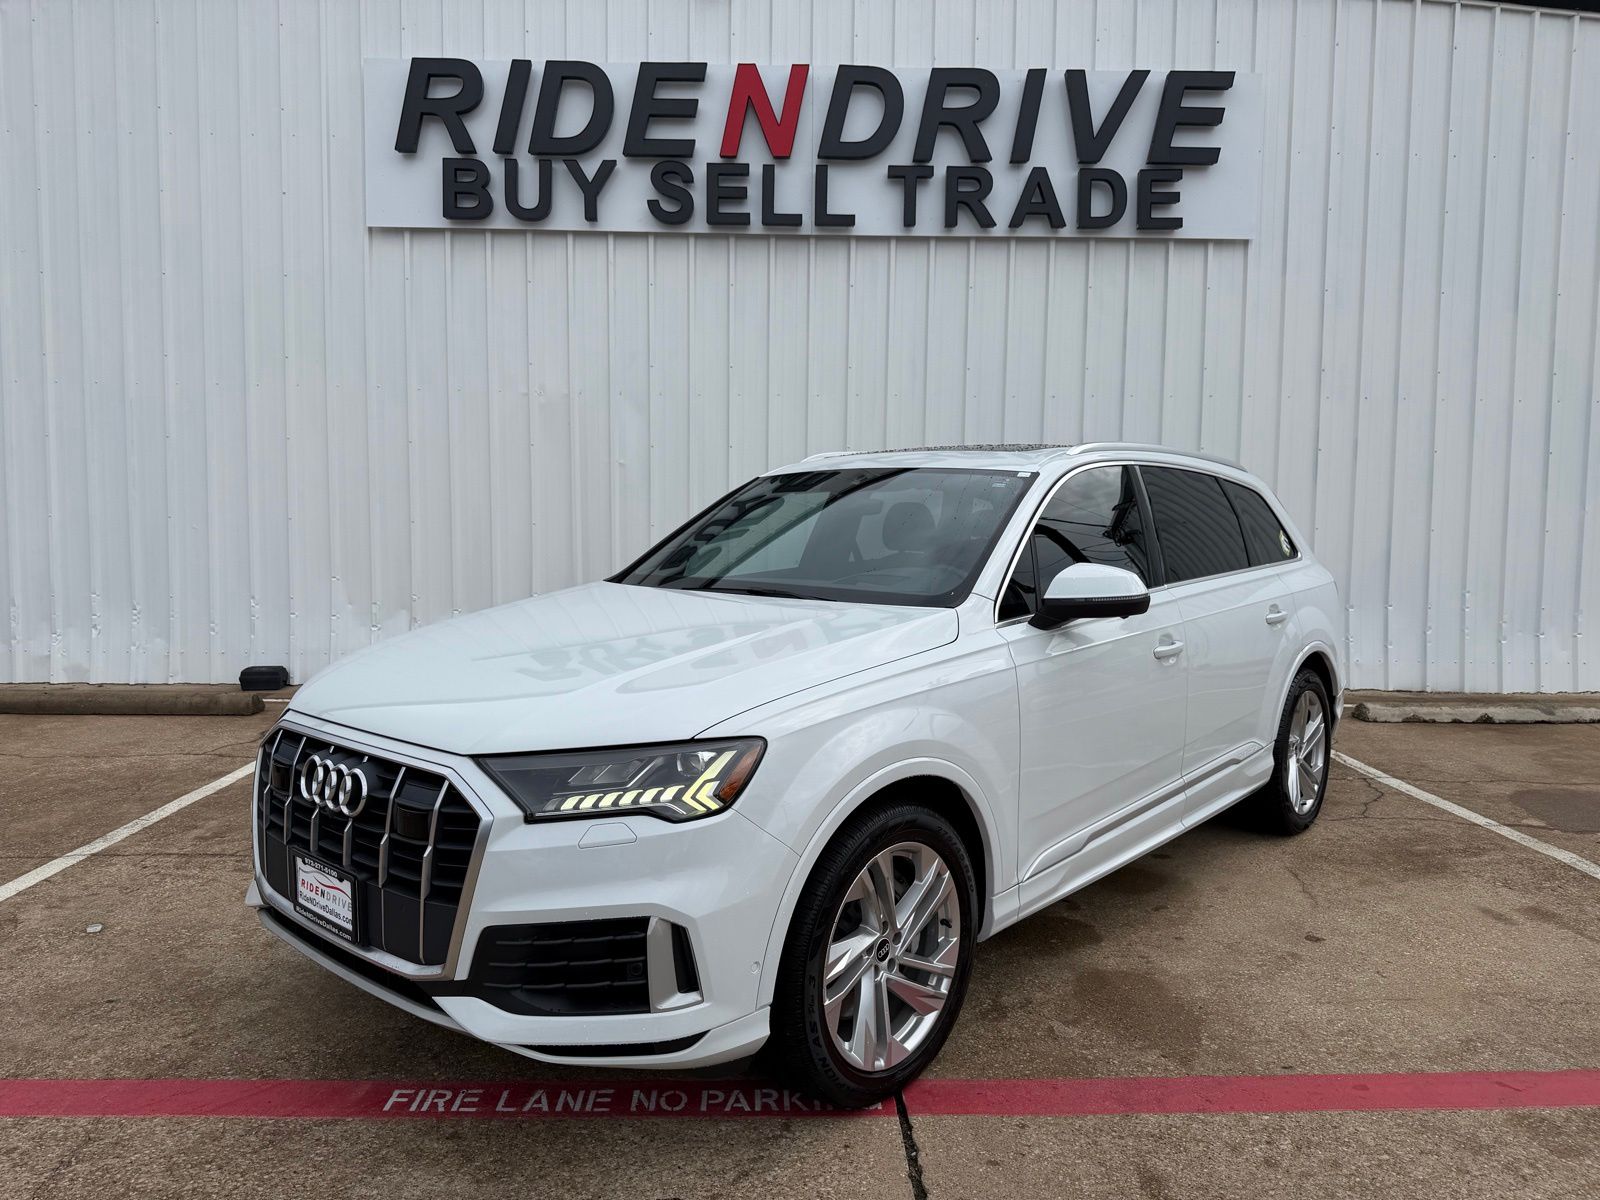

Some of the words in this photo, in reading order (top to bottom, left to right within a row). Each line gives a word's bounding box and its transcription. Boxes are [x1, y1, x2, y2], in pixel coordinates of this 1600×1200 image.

[442, 157, 617, 222] BUY
[647, 161, 856, 228] SELL
[887, 165, 1184, 231] TRADE
[301, 878, 353, 912] RIDENDRIVE
[295, 905, 352, 941] RideNDriveDallas.com
[383, 1088, 484, 1112] FIRE
[496, 1088, 616, 1112] LANE
[631, 1088, 688, 1112] NO
